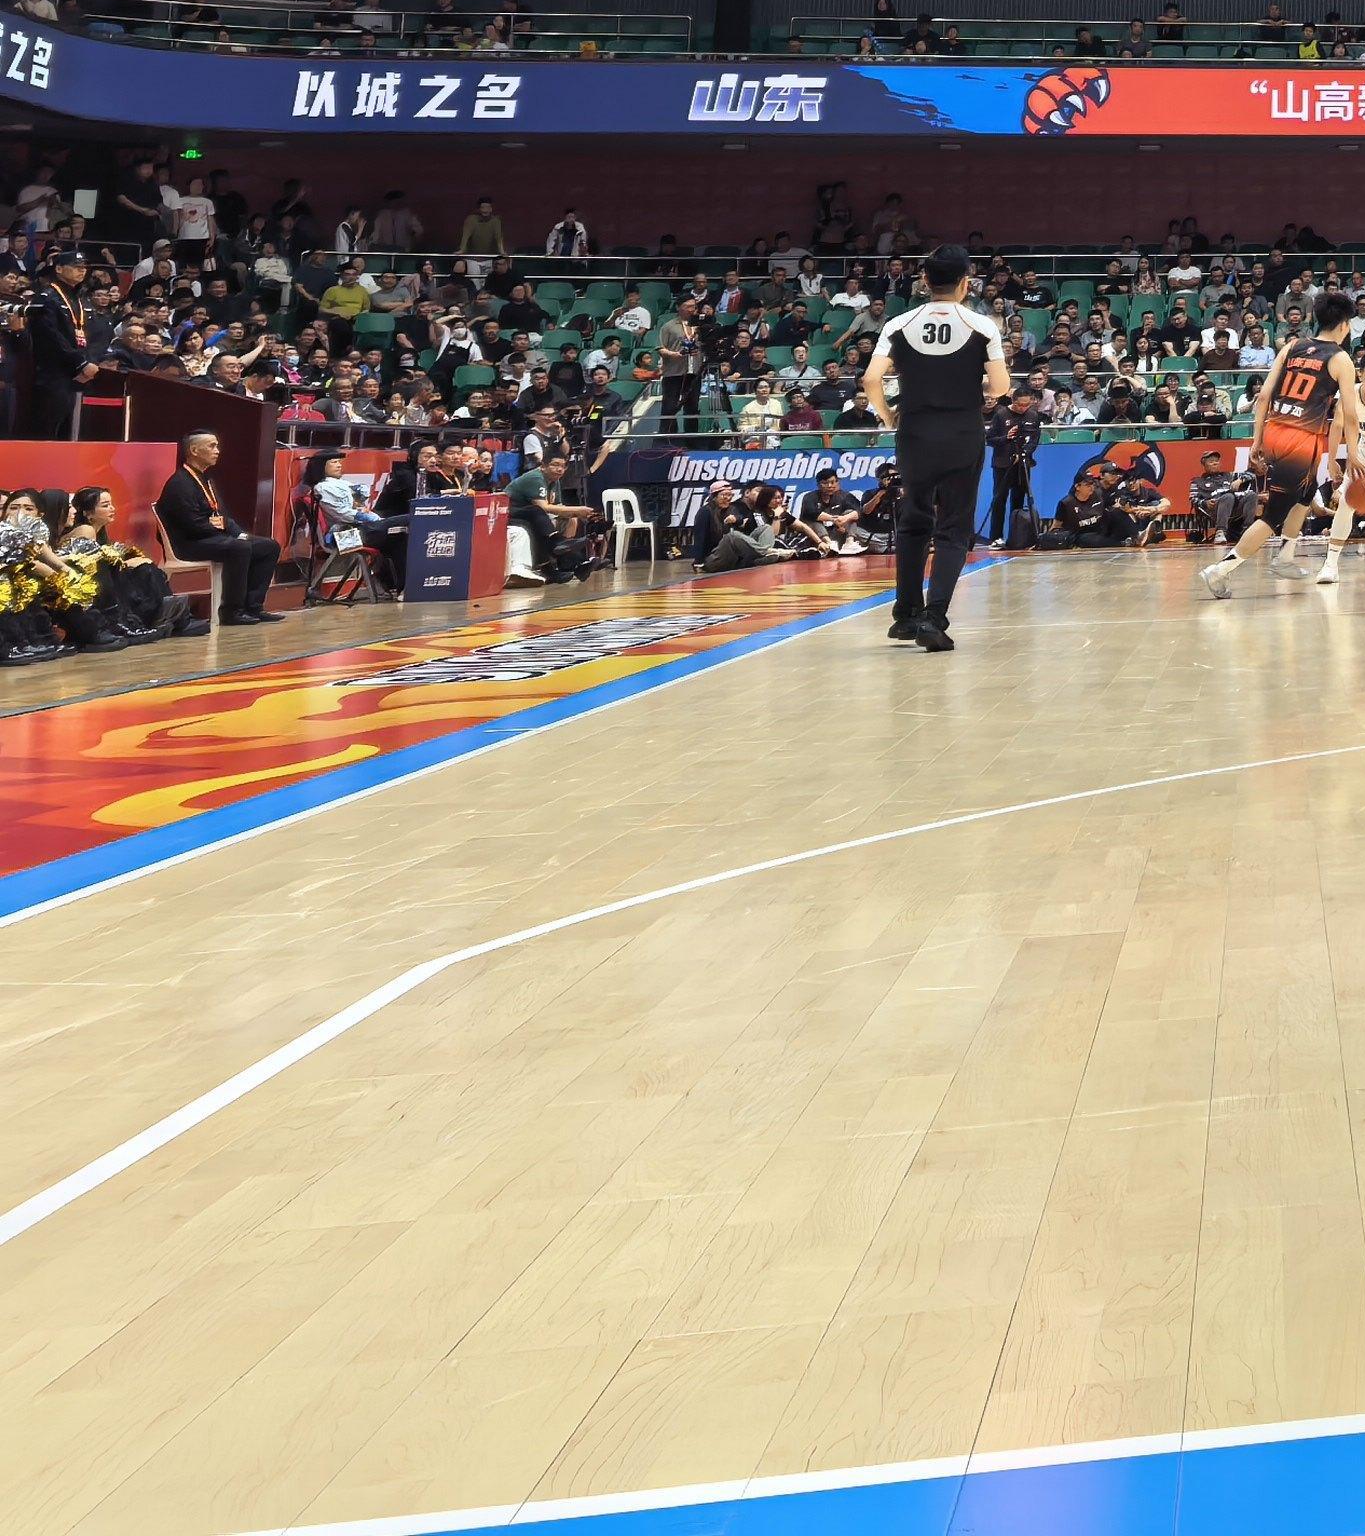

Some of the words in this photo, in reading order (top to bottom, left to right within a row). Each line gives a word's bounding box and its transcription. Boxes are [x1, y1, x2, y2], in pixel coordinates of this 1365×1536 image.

[291, 70, 521, 119] 以城之名
[688, 73, 826, 122] 山东
[922, 323, 951, 345] 30
[1281, 369, 1317, 401] 10
[668, 453, 831, 483] Unstoppable
